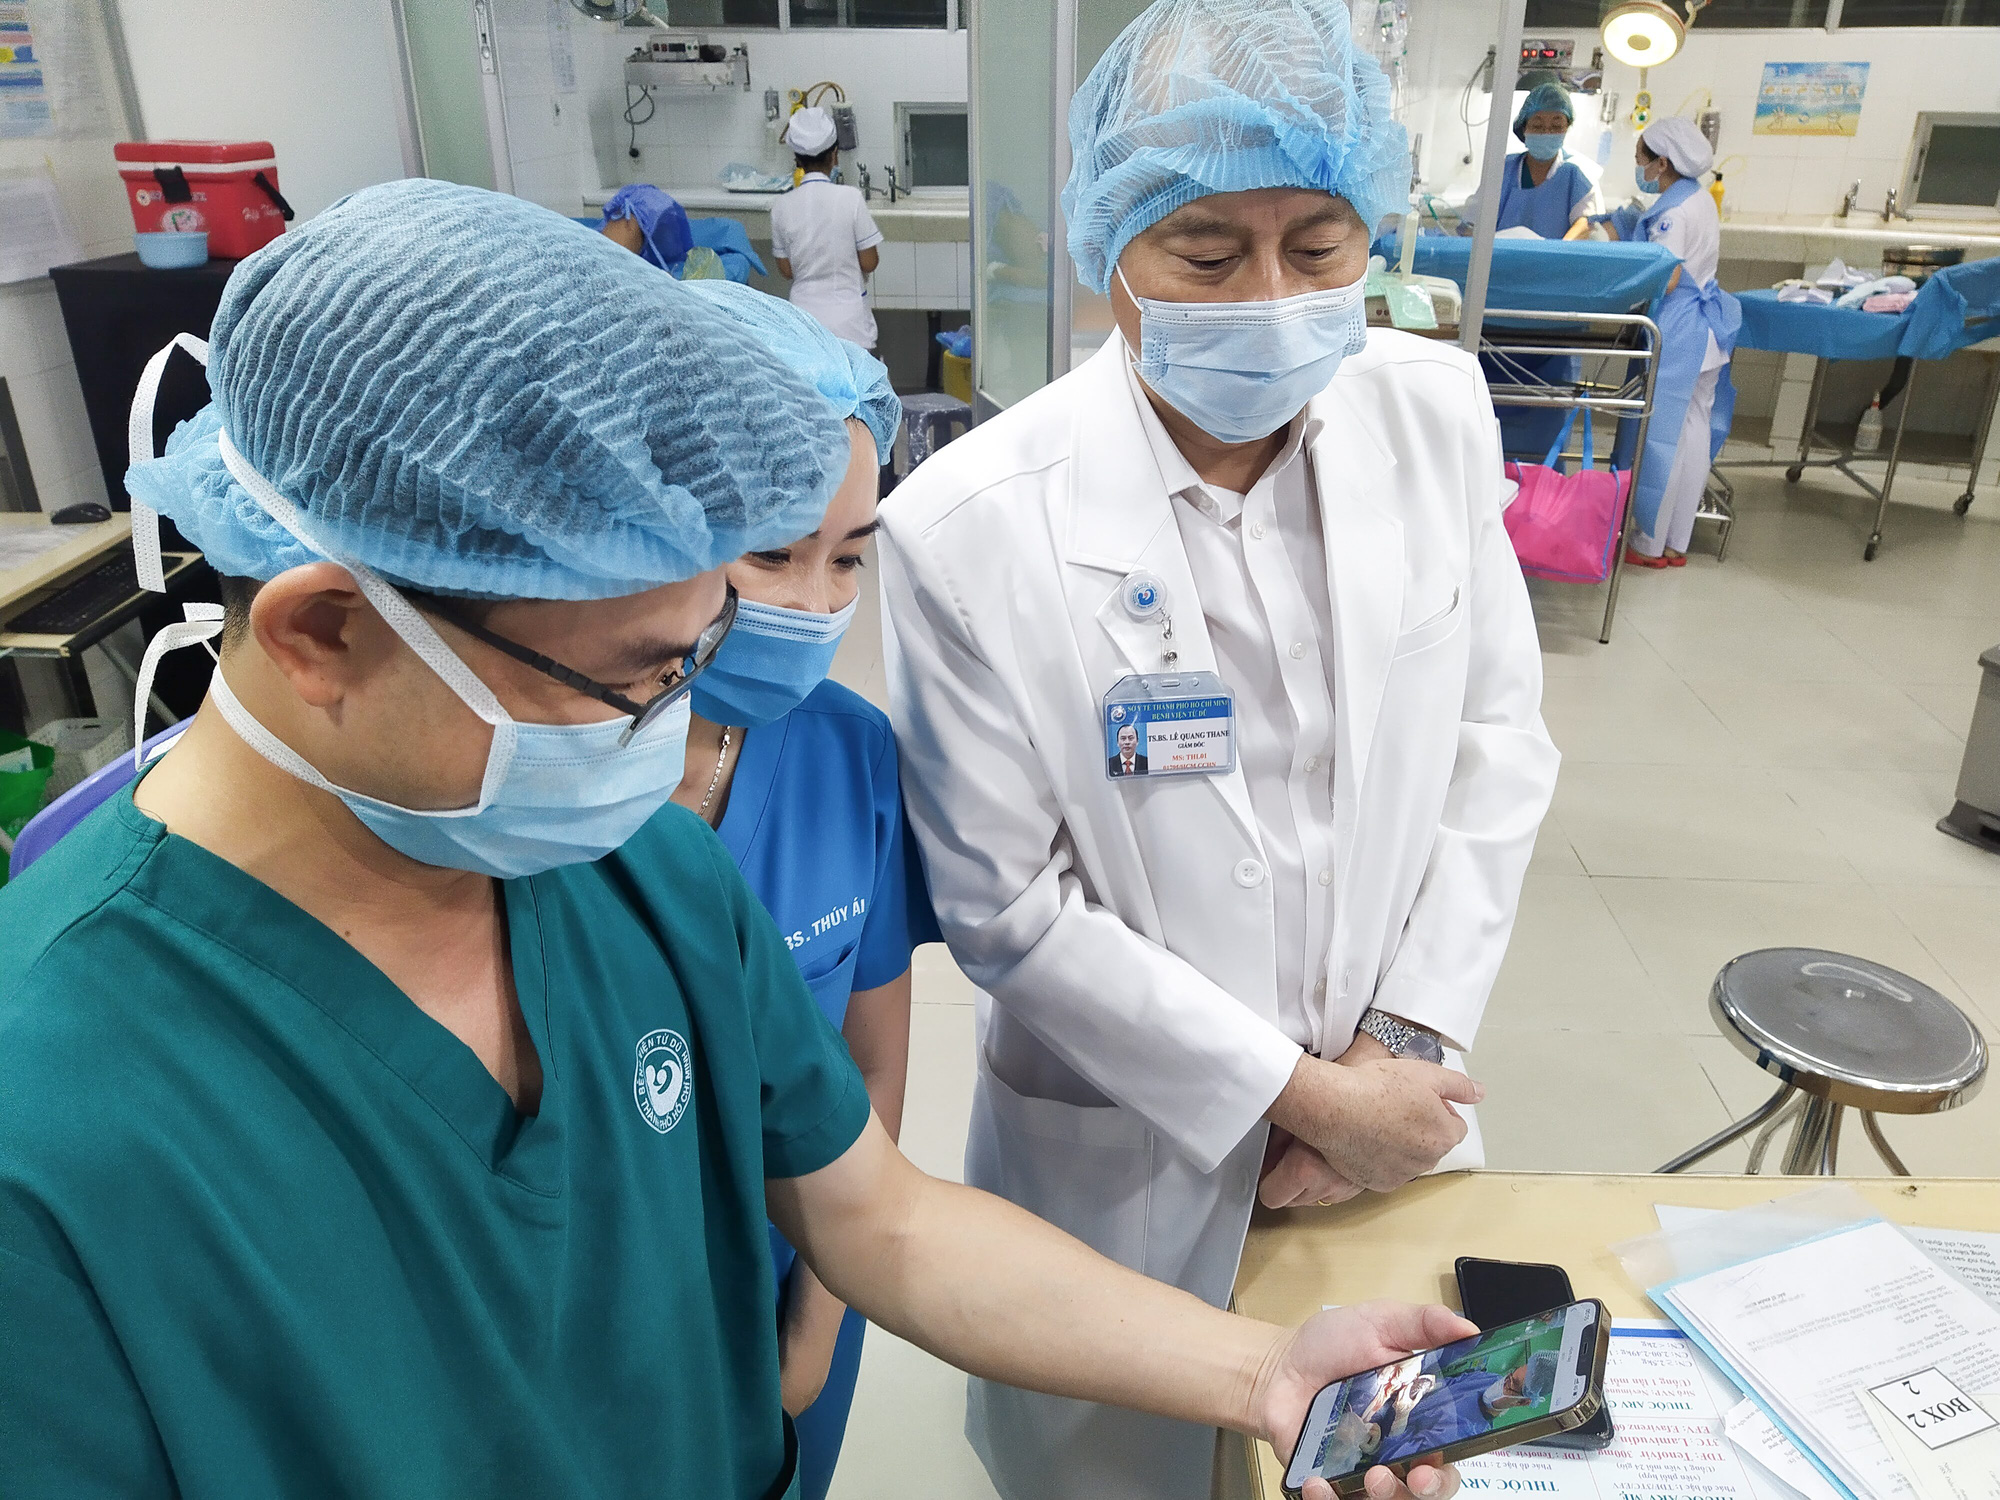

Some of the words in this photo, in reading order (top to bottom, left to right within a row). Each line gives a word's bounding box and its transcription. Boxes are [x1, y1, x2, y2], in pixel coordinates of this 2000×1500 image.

[1169, 731, 1179, 741] LÊ
[1179, 732, 1206, 741] QUANG
[811, 905, 848, 937] THÚY
[852, 896, 866, 917] ÁI
[1902, 1380, 1920, 1395] 2
[1621, 1400, 1644, 1410] ARV
[1648, 1401, 1693, 1412] THUỐC
[1920, 1397, 1971, 1424] BOX
[1907, 1413, 1926, 1428] 2
[1628, 1424, 1679, 1434] Efavirenz
[1682, 1425, 1710, 1435] EFV:
[1620, 1436, 1689, 1448] Lamivudin
[1695, 1452, 1724, 1461] TDF:
[1495, 1479, 1559, 1493] THUỐC
